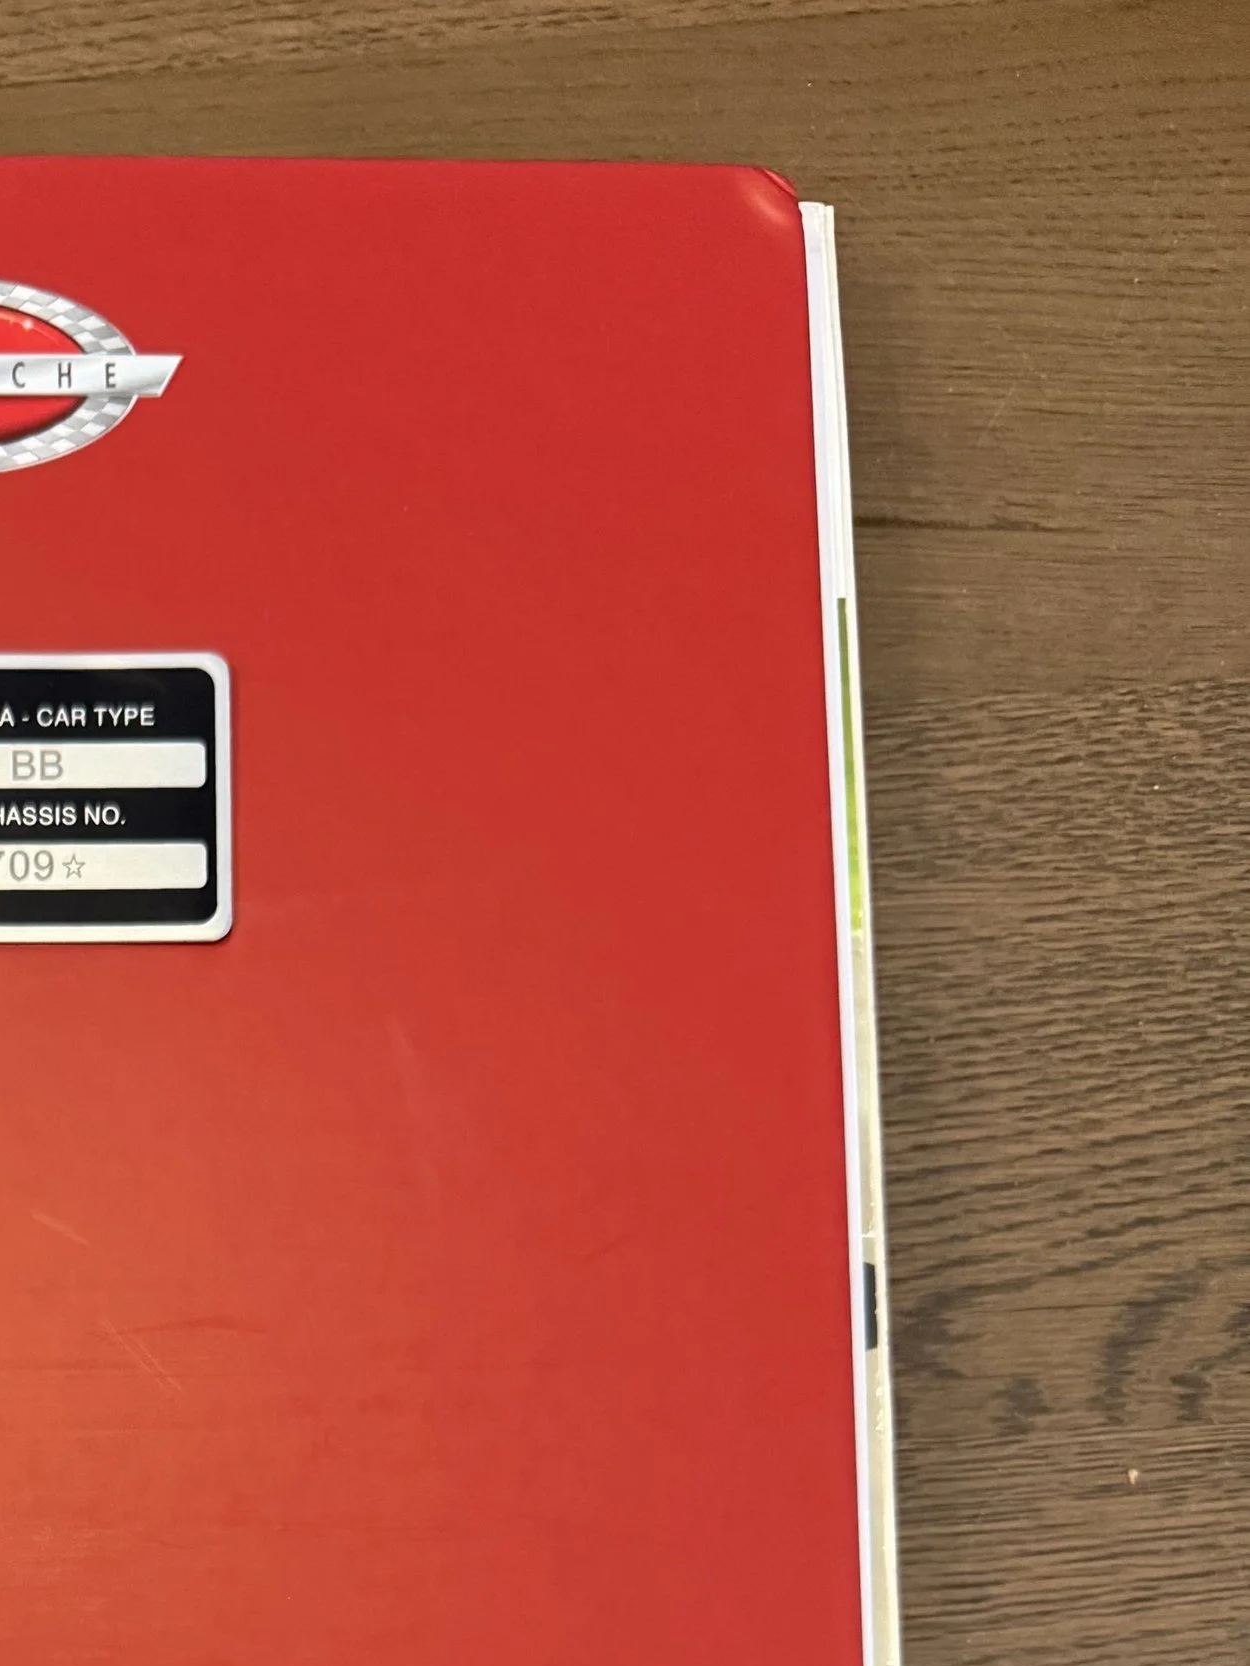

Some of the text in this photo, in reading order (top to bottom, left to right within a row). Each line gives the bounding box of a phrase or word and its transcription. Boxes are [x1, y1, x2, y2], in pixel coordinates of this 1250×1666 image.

[36, 706, 87, 727] CAR
[95, 706, 155, 727] TYPE
[12, 750, 64, 780] BB
[84, 805, 126, 826] NO.
